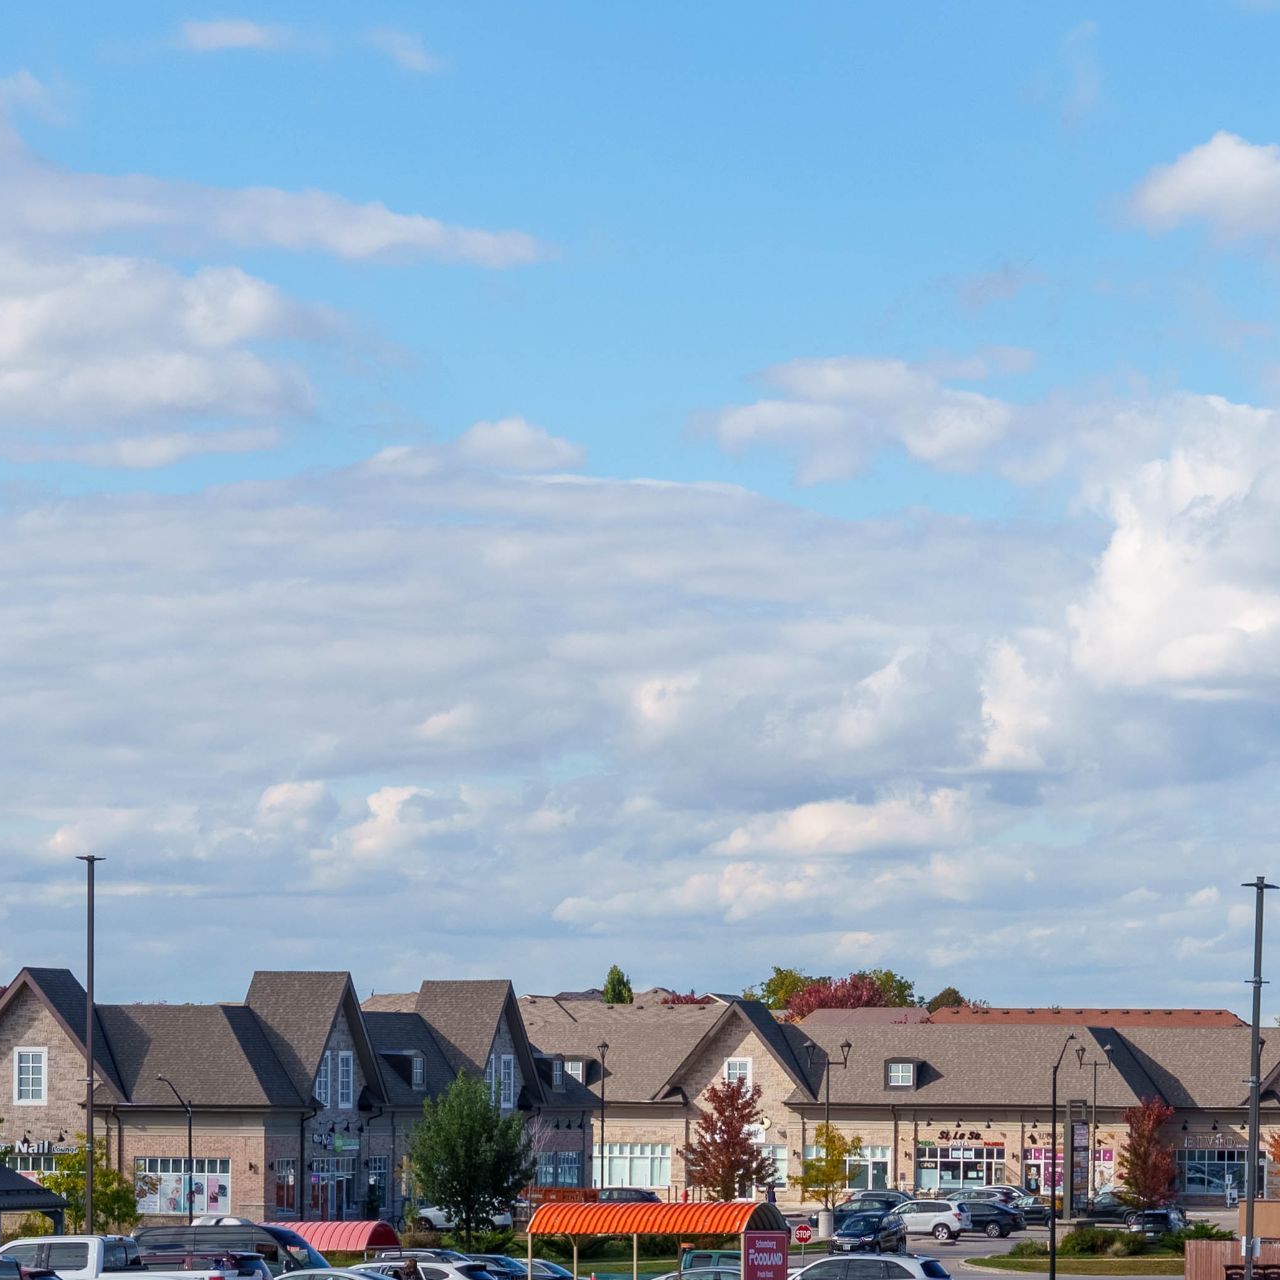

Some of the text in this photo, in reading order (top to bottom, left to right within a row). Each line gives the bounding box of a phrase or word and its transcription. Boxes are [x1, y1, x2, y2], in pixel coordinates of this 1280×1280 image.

[15, 1140, 49, 1154] Nail
[796, 1230, 811, 1239] STOP
[749, 1249, 783, 1265] FOODLAND
